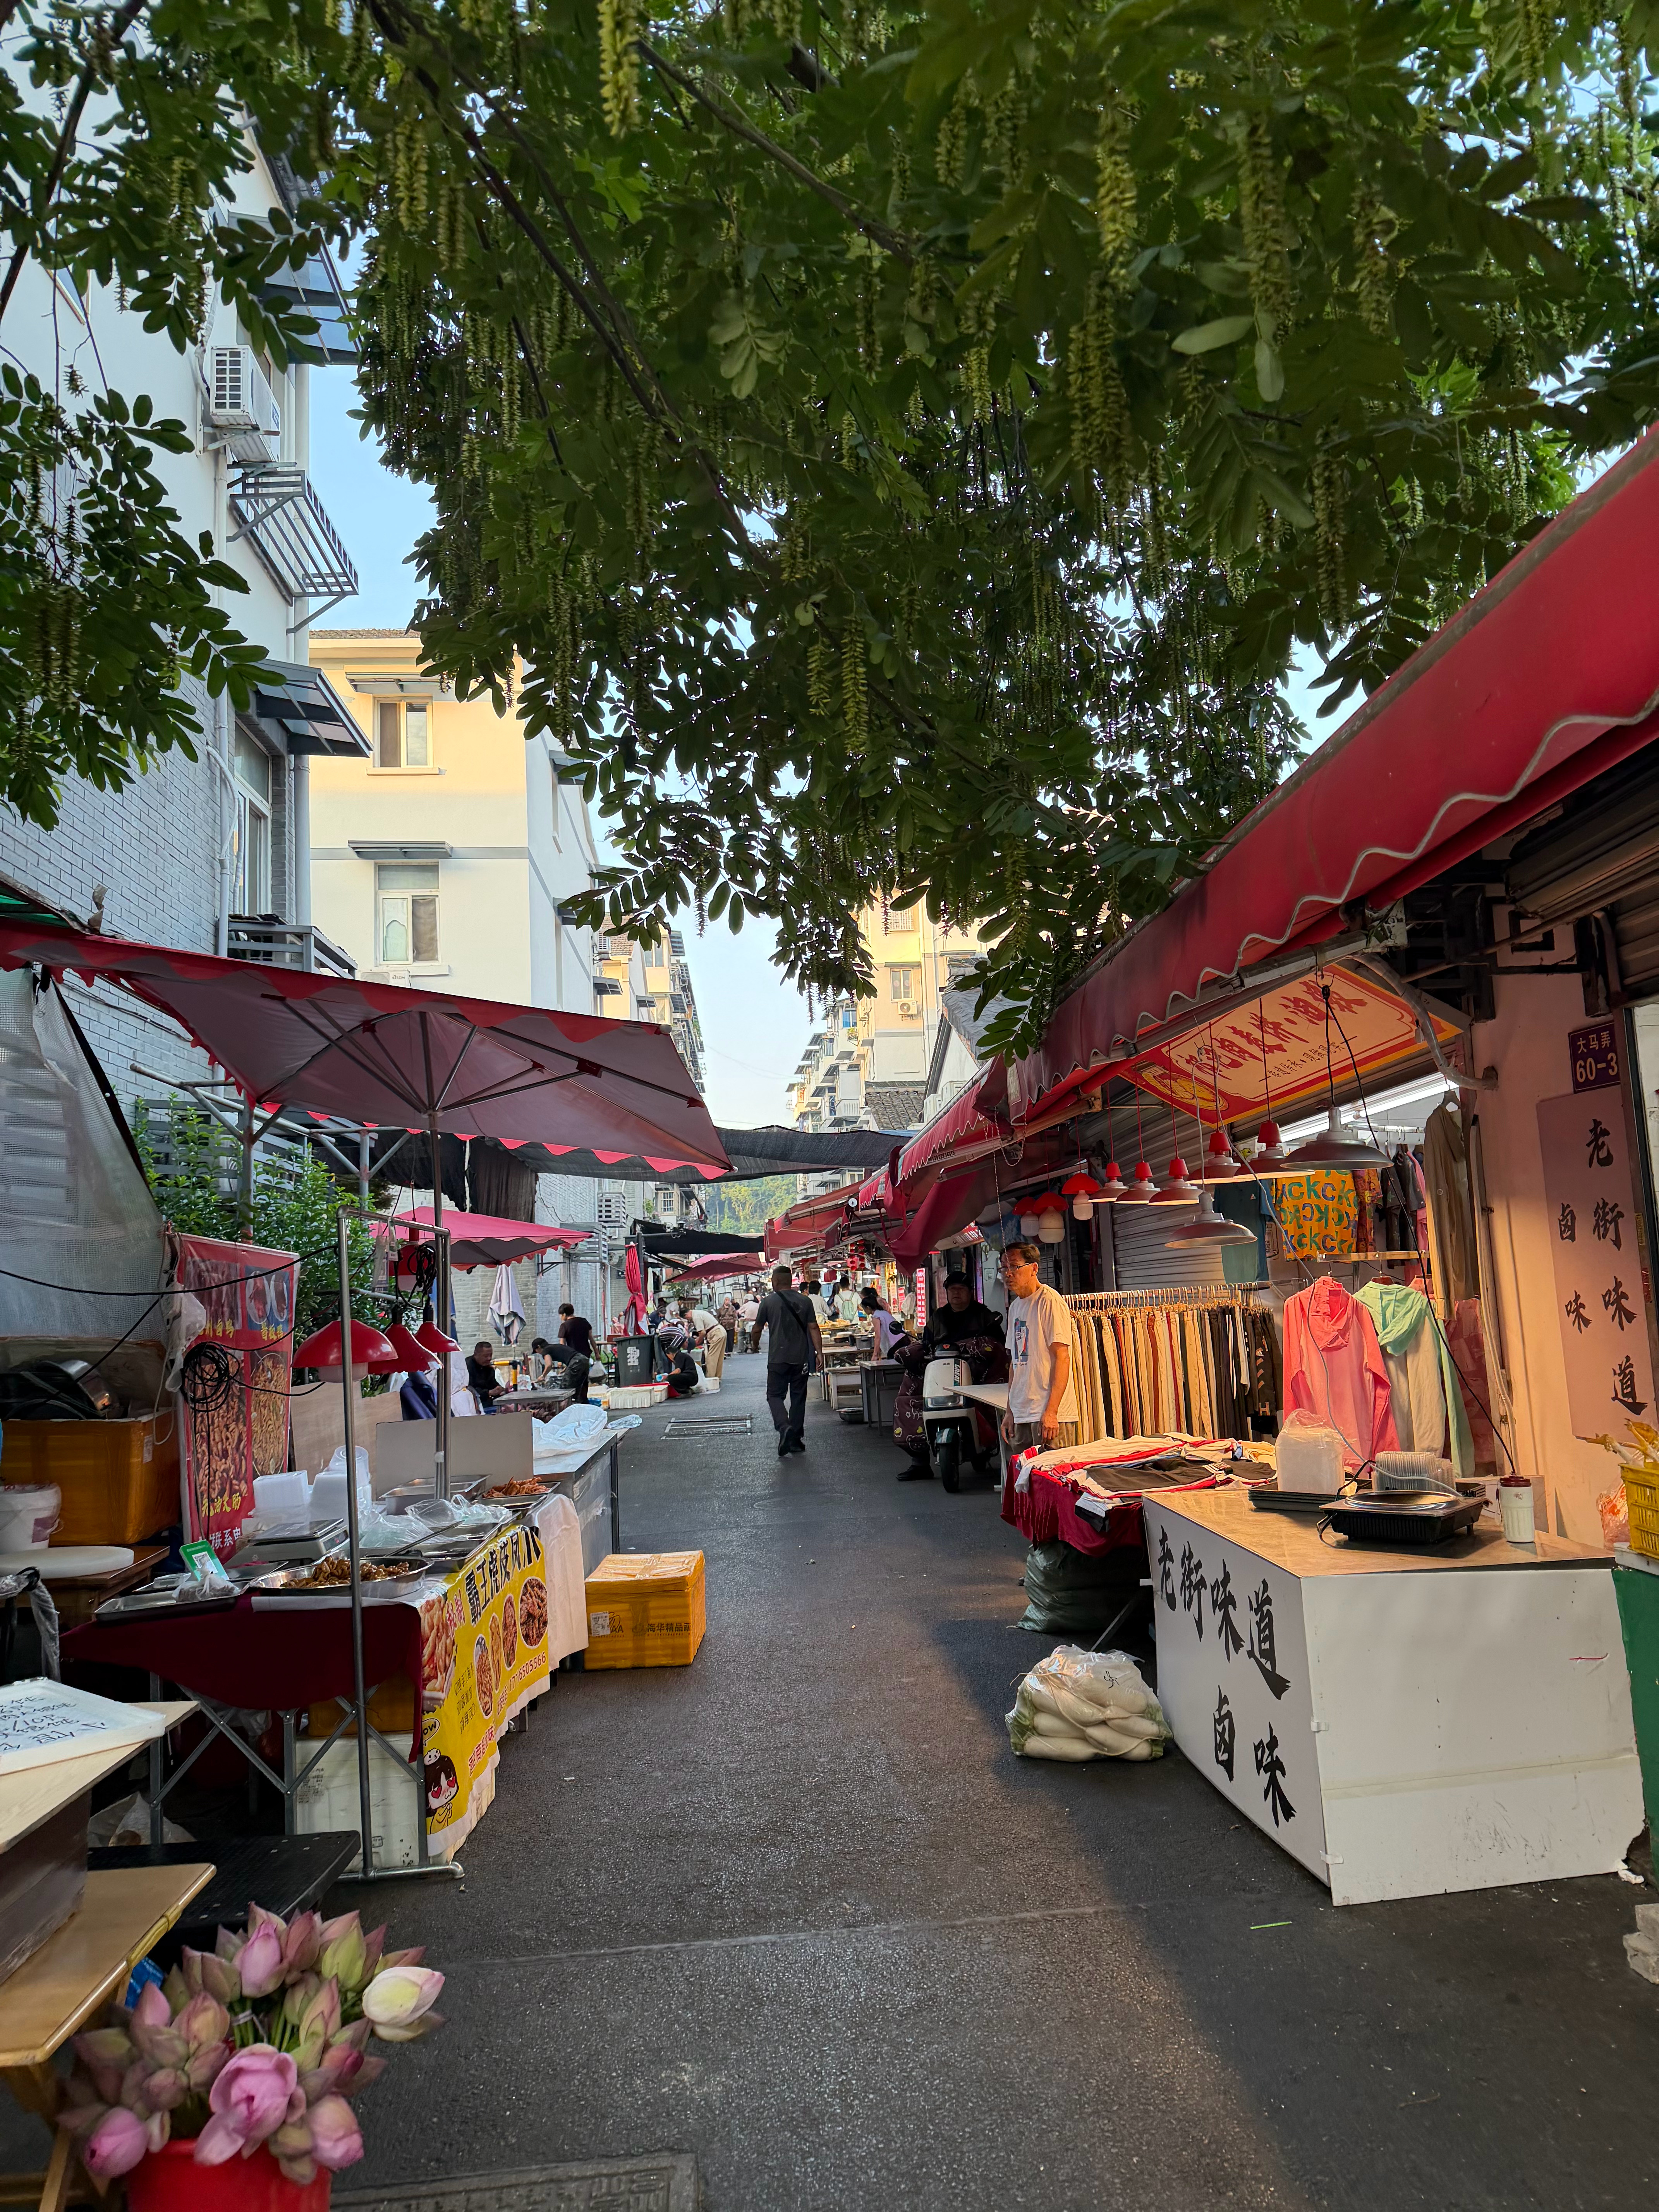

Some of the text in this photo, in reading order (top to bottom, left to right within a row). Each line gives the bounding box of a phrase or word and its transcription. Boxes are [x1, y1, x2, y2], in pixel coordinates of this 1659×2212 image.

[1577, 1031, 1611, 1054] 大马弄
[1577, 1052, 1618, 1082] 60-3
[1558, 1202, 1592, 1334] 卤味
[1585, 1119, 1648, 1416] 老街味道
[465, 1524, 541, 1626] 霸王虎皮凤爪
[1158, 1525, 1290, 1700] 老街味道
[1214, 1685, 1296, 1827] 卤味
